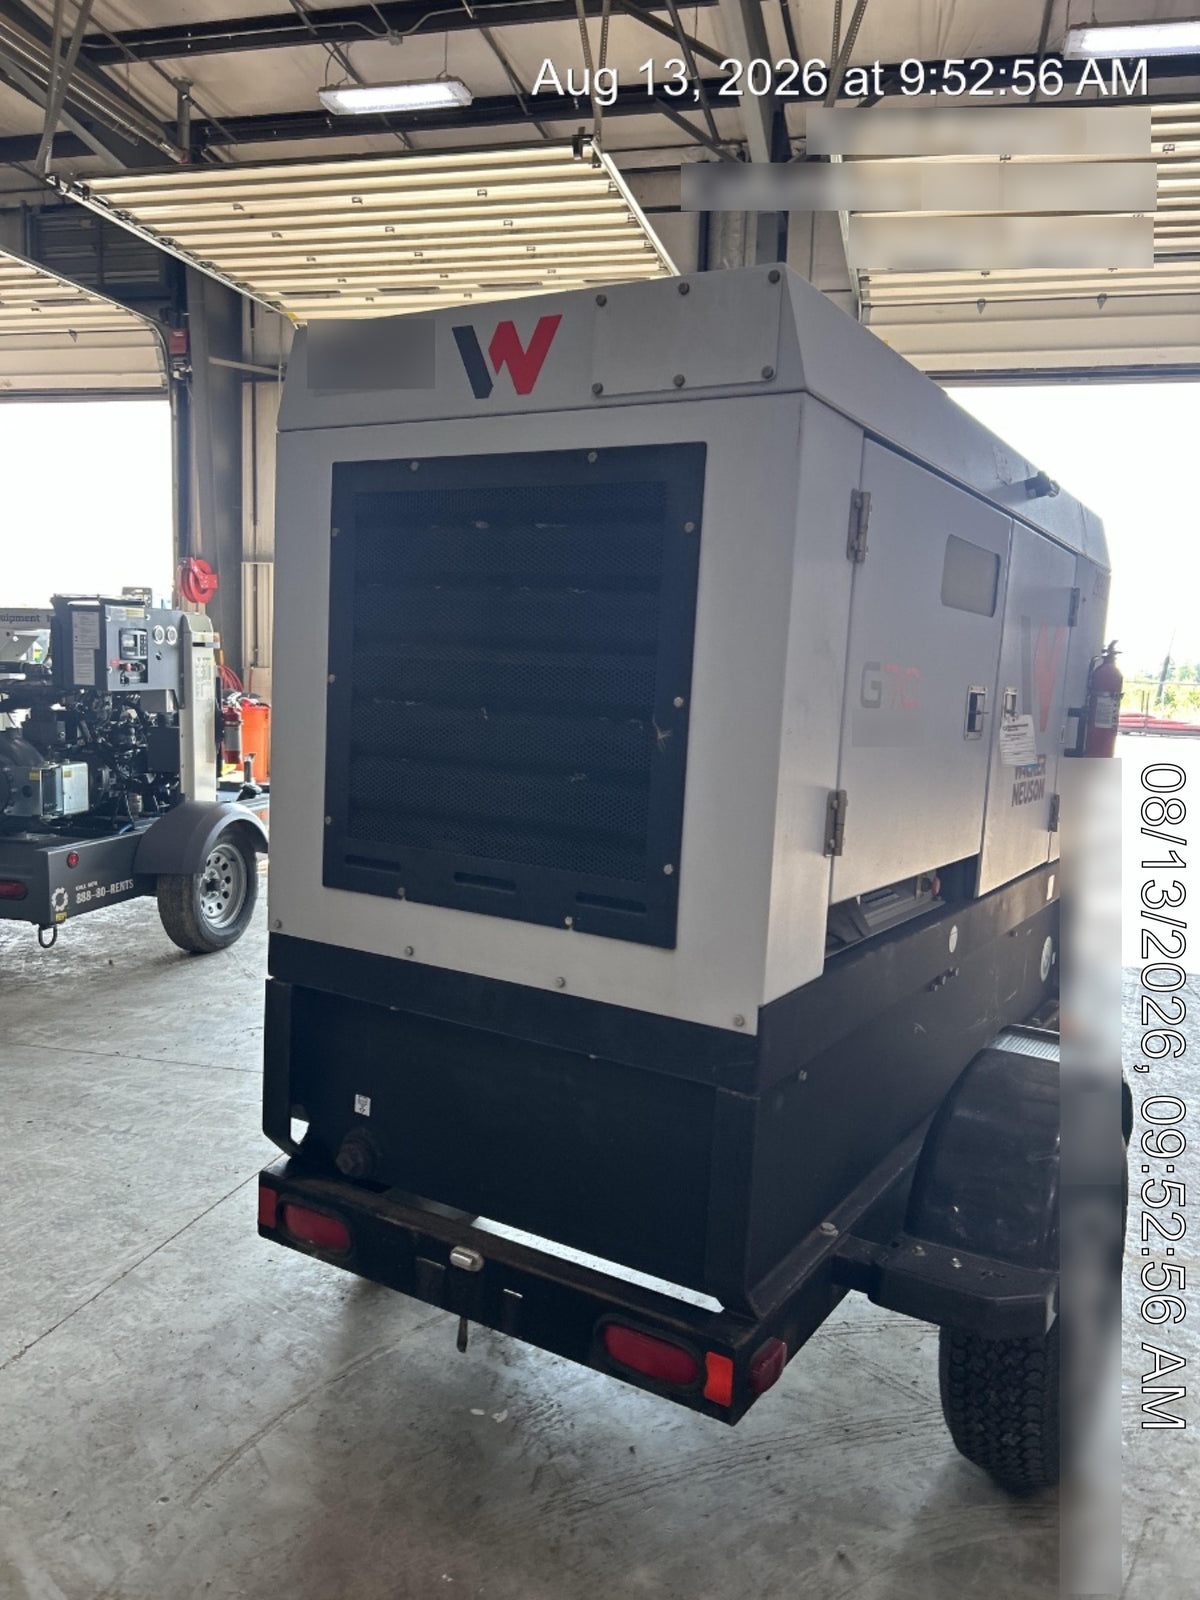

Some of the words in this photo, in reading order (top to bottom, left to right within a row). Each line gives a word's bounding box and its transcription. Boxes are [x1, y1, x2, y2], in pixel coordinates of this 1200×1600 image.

[860, 661, 923, 709] G70
[1011, 777, 1046, 807] NEUSON
[76, 879, 134, 904] 888-80-RENTS
